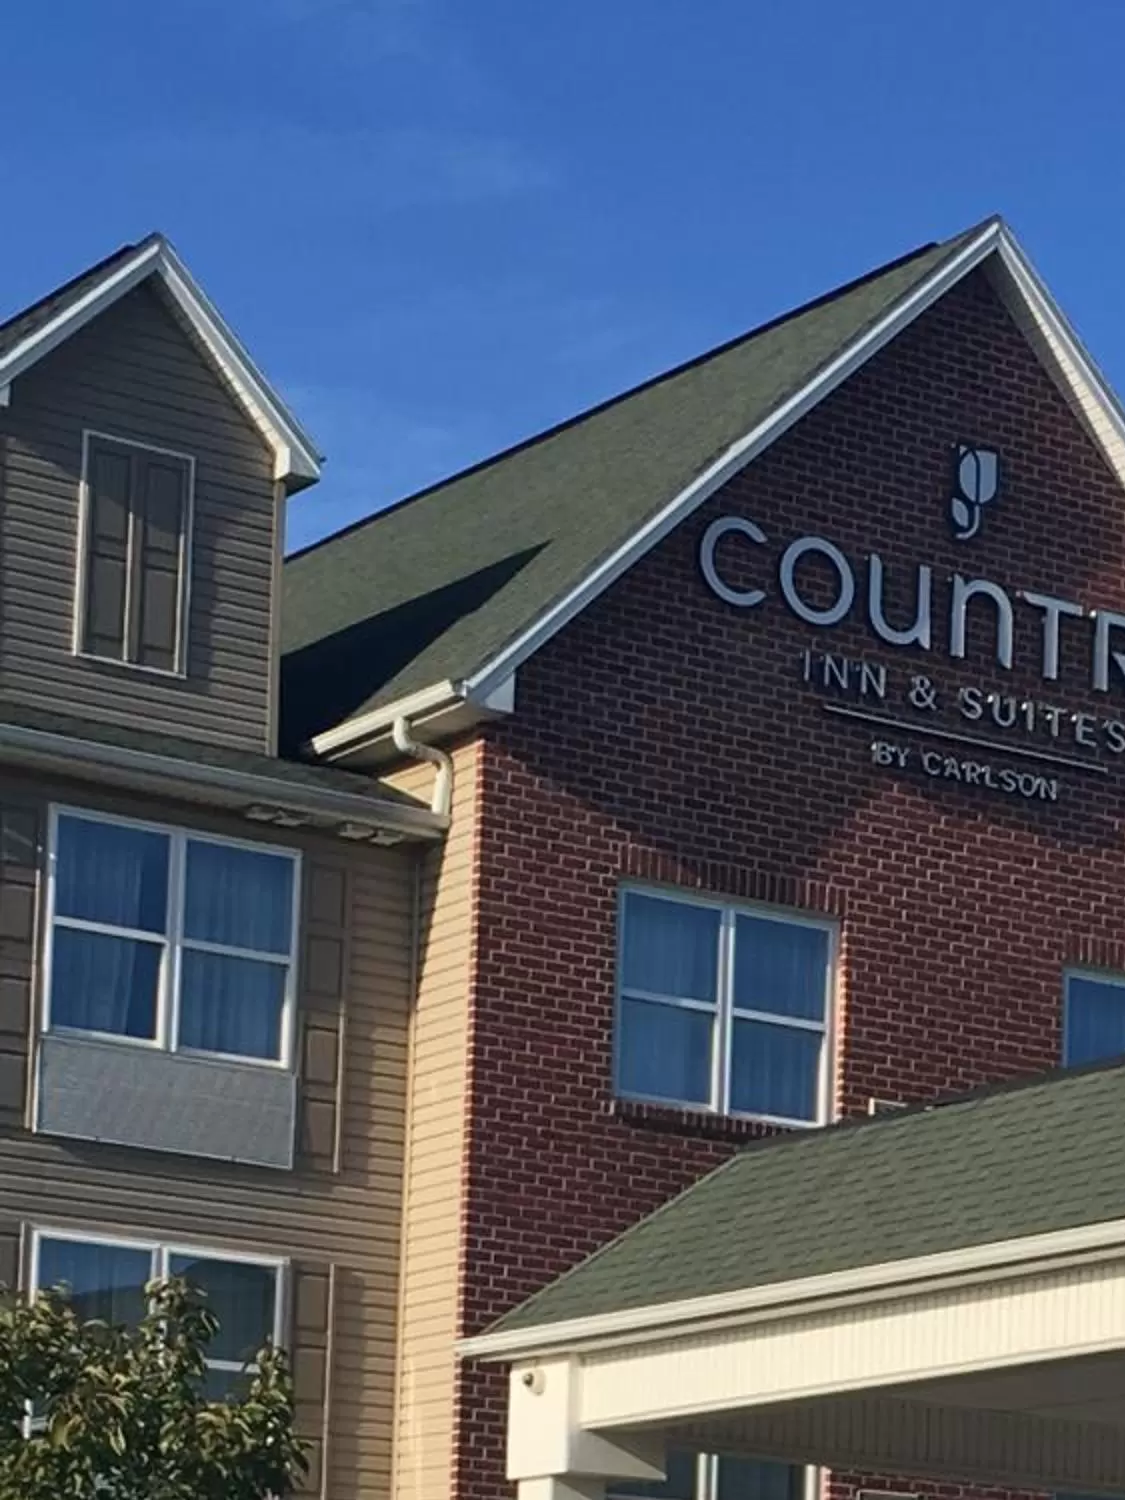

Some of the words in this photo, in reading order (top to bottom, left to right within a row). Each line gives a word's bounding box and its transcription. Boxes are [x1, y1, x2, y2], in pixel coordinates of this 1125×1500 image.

[802, 649, 887, 698] INN
[910, 676, 937, 711] &
[871, 741, 907, 768] BY
[922, 751, 1058, 800] CARLSON
